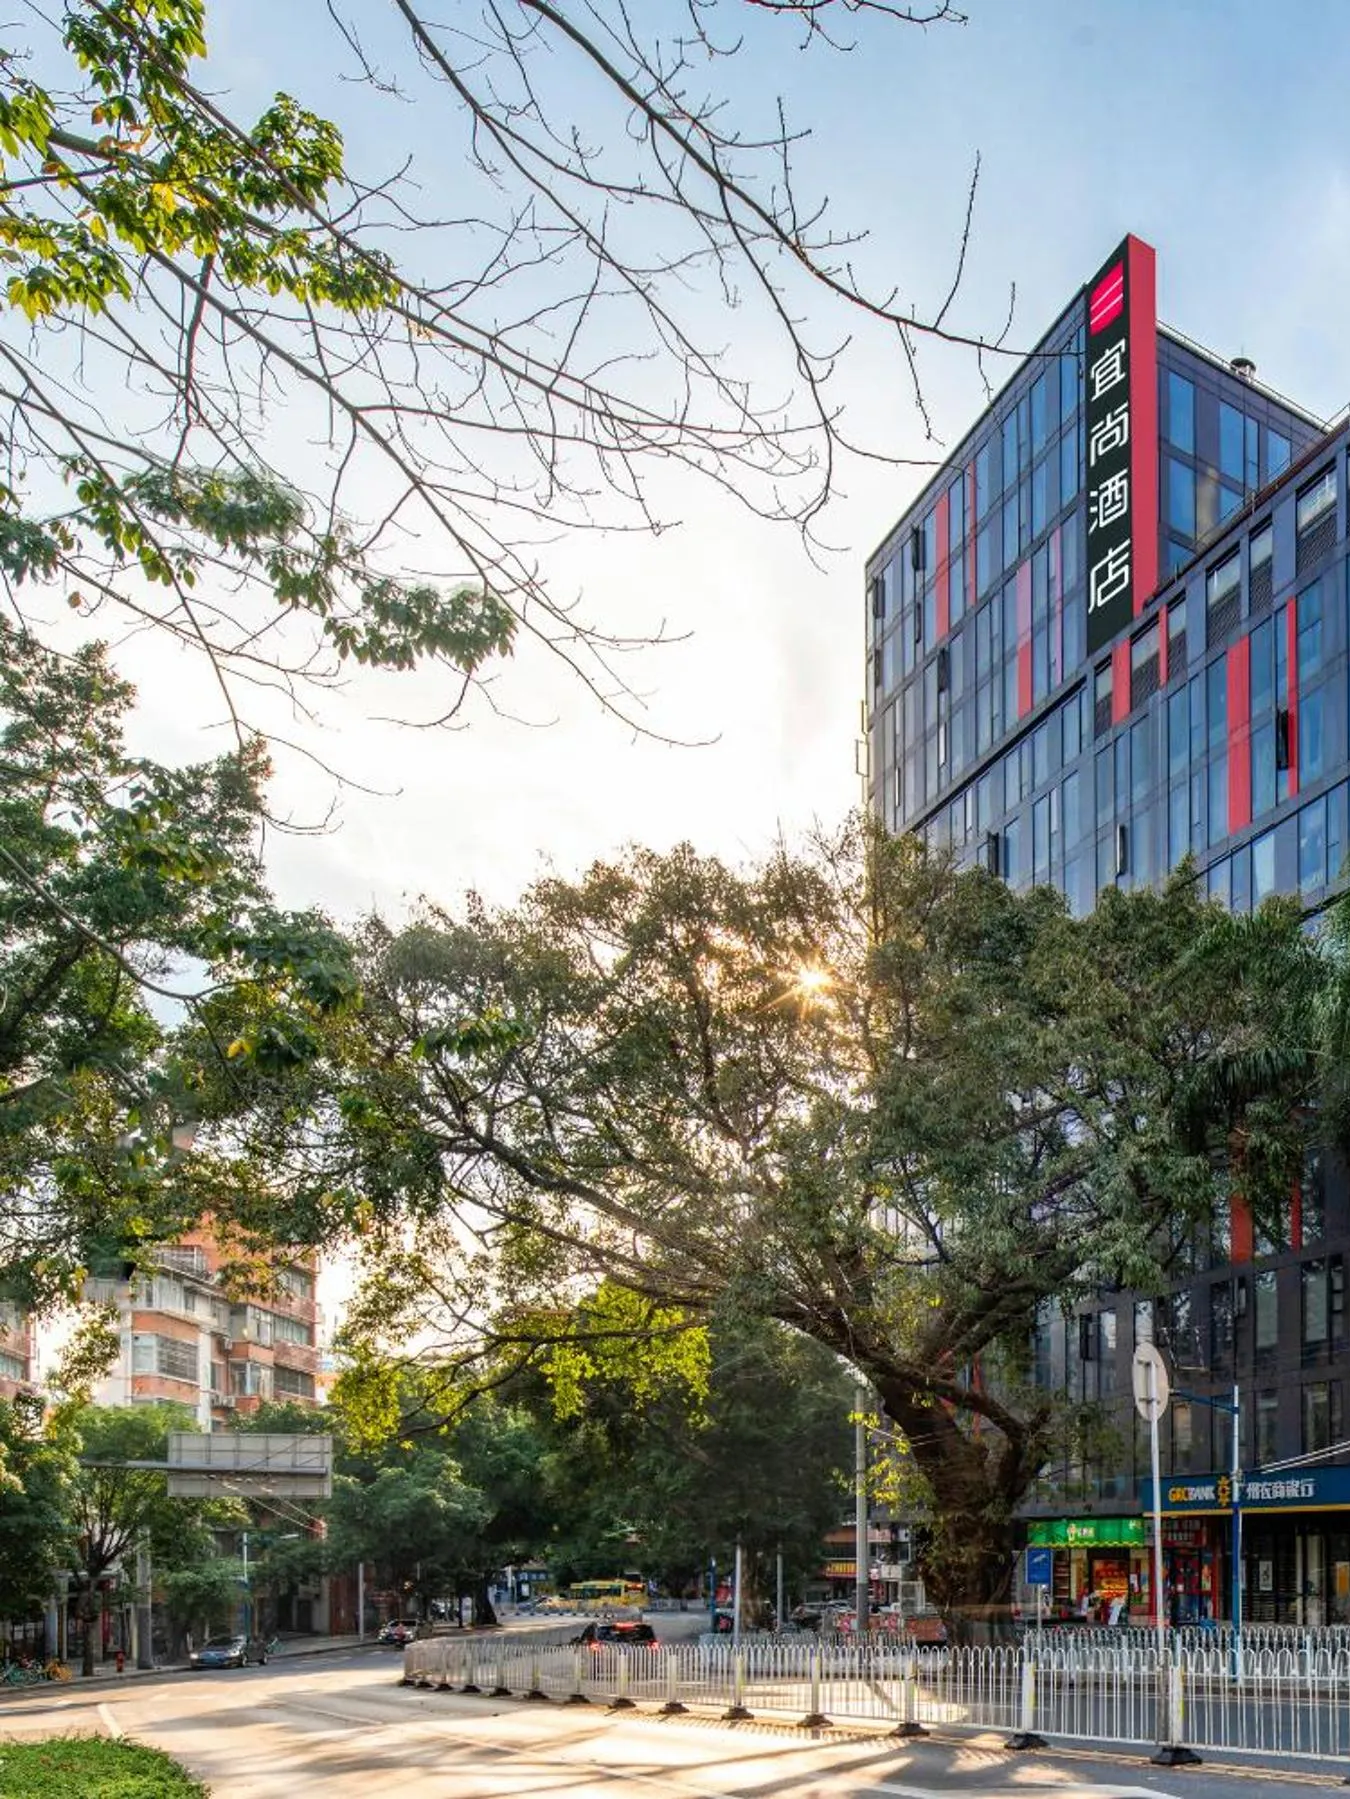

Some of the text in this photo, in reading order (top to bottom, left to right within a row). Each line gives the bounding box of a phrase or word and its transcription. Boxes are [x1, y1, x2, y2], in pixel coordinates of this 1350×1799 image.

[1089, 338, 1131, 615] 宜尚酒店
[1168, 1486, 1216, 1502] GRCBANK
